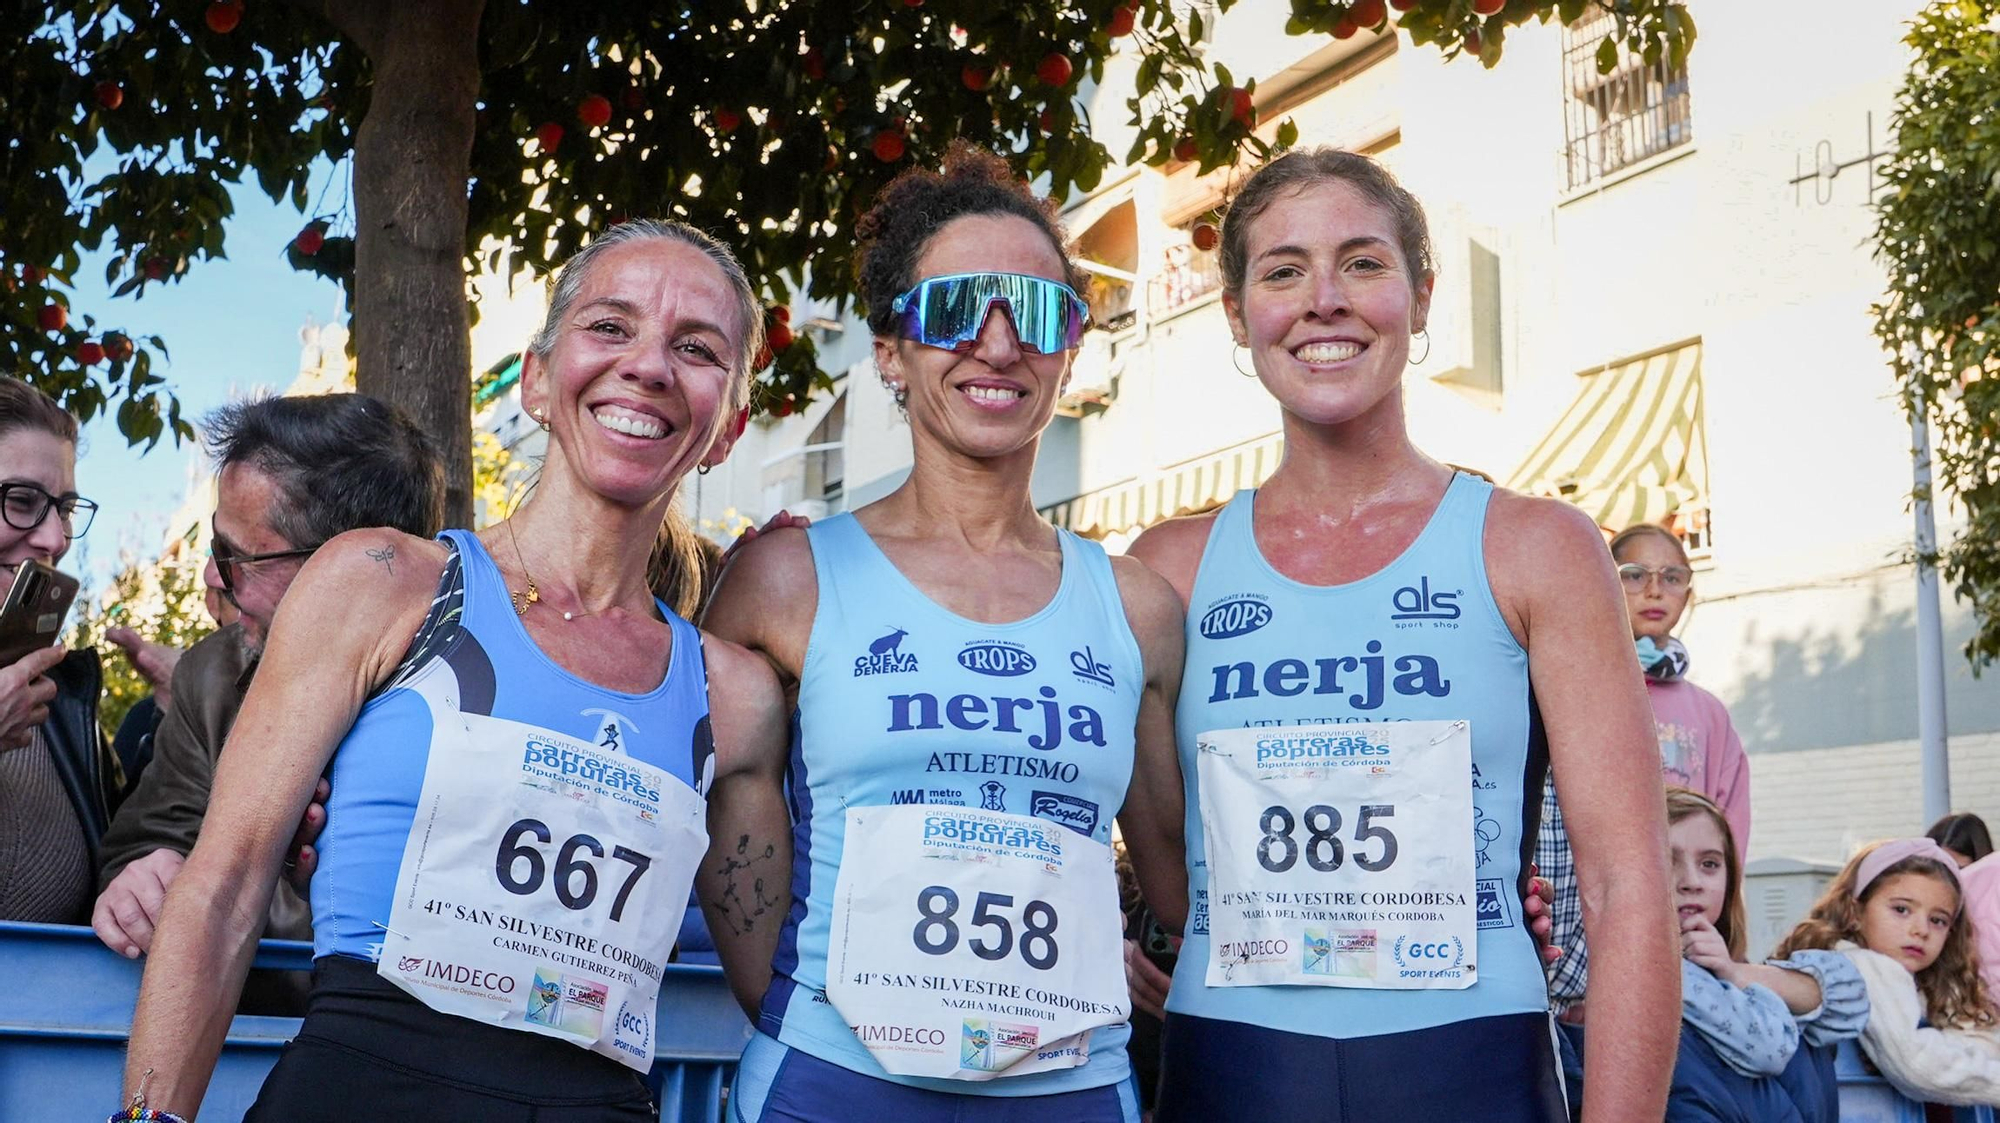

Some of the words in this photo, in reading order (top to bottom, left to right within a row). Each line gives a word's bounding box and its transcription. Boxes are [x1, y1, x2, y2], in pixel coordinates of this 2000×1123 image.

[1203, 602, 1269, 635] TROPS
[1395, 622, 1423, 630] sport
[1433, 621, 1460, 630] shop
[855, 653, 919, 668] CUEVA
[961, 647, 1034, 671] TROPS
[1208, 640, 1451, 711] nerja
[887, 686, 1107, 751] nerja
[1256, 736, 1368, 750] carreras
[1257, 731, 1303, 740] CIRCUITO
[1305, 730, 1367, 738] PROVINCIAL
[526, 740, 642, 786] carreras
[527, 732, 580, 753] CIRCUITO
[581, 750, 640, 775] PROVINCIAL
[1257, 743, 1391, 761] populares
[1257, 758, 1319, 769] Diputación
[1322, 759, 1338, 767] de
[1341, 758, 1391, 767] Córdoba
[523, 749, 660, 803] populares
[926, 752, 1080, 784] ATLETISMO
[522, 764, 590, 791] Diputación
[594, 785, 609, 797] de
[612, 791, 659, 815] Córdoba
[929, 789, 962, 797] metro
[925, 810, 977, 821] CIRCUITO
[979, 815, 1044, 830] PROVINCIAL
[1035, 798, 1092, 823] Rogelio
[923, 825, 1062, 856] populares
[924, 816, 1045, 842] carreras
[1256, 805, 1399, 873] 885
[923, 839, 992, 853] Diputación
[995, 846, 1011, 856] de
[1014, 850, 1063, 866] Córdoba
[496, 819, 652, 923] 667
[1265, 892, 1356, 905] SILVESTRE
[1361, 892, 1467, 906] CORDOBESA
[1242, 907, 1272, 920] MARÍA
[1275, 909, 1298, 920] DEL
[1300, 911, 1327, 921] MAR
[1328, 909, 1385, 922] MARQUÉS
[1388, 911, 1445, 922] CORDOBA
[454, 904, 495, 927] SAN
[498, 914, 599, 954] SILVESTRE
[912, 885, 1059, 971] 858
[1232, 939, 1288, 956] IMDECO
[1409, 943, 1449, 959] GCC
[493, 936, 550, 959] CARMEN
[551, 950, 616, 979] GUTIERREZ
[617, 970, 638, 988] PEÑA
[1400, 970, 1426, 978] SPORT
[424, 959, 516, 994] IMDECO
[459, 987, 487, 999] Deportes
[568, 988, 578, 997] EL
[578, 990, 605, 1006] PARQUE
[881, 973, 917, 988] SAN
[922, 975, 1021, 999] SILVESTRE
[1025, 988, 1123, 1017] CORDOBESA
[941, 998, 985, 1011] NAZHA
[987, 1003, 1056, 1022] MACHROUH
[622, 1012, 642, 1035] GCC
[863, 1025, 946, 1046] IMDECO
[613, 1039, 630, 1053] SPORT
[629, 1044, 647, 1059] EVENTS
[1006, 1033, 1037, 1045] PARQUE
[1038, 1049, 1064, 1060] SPORT
